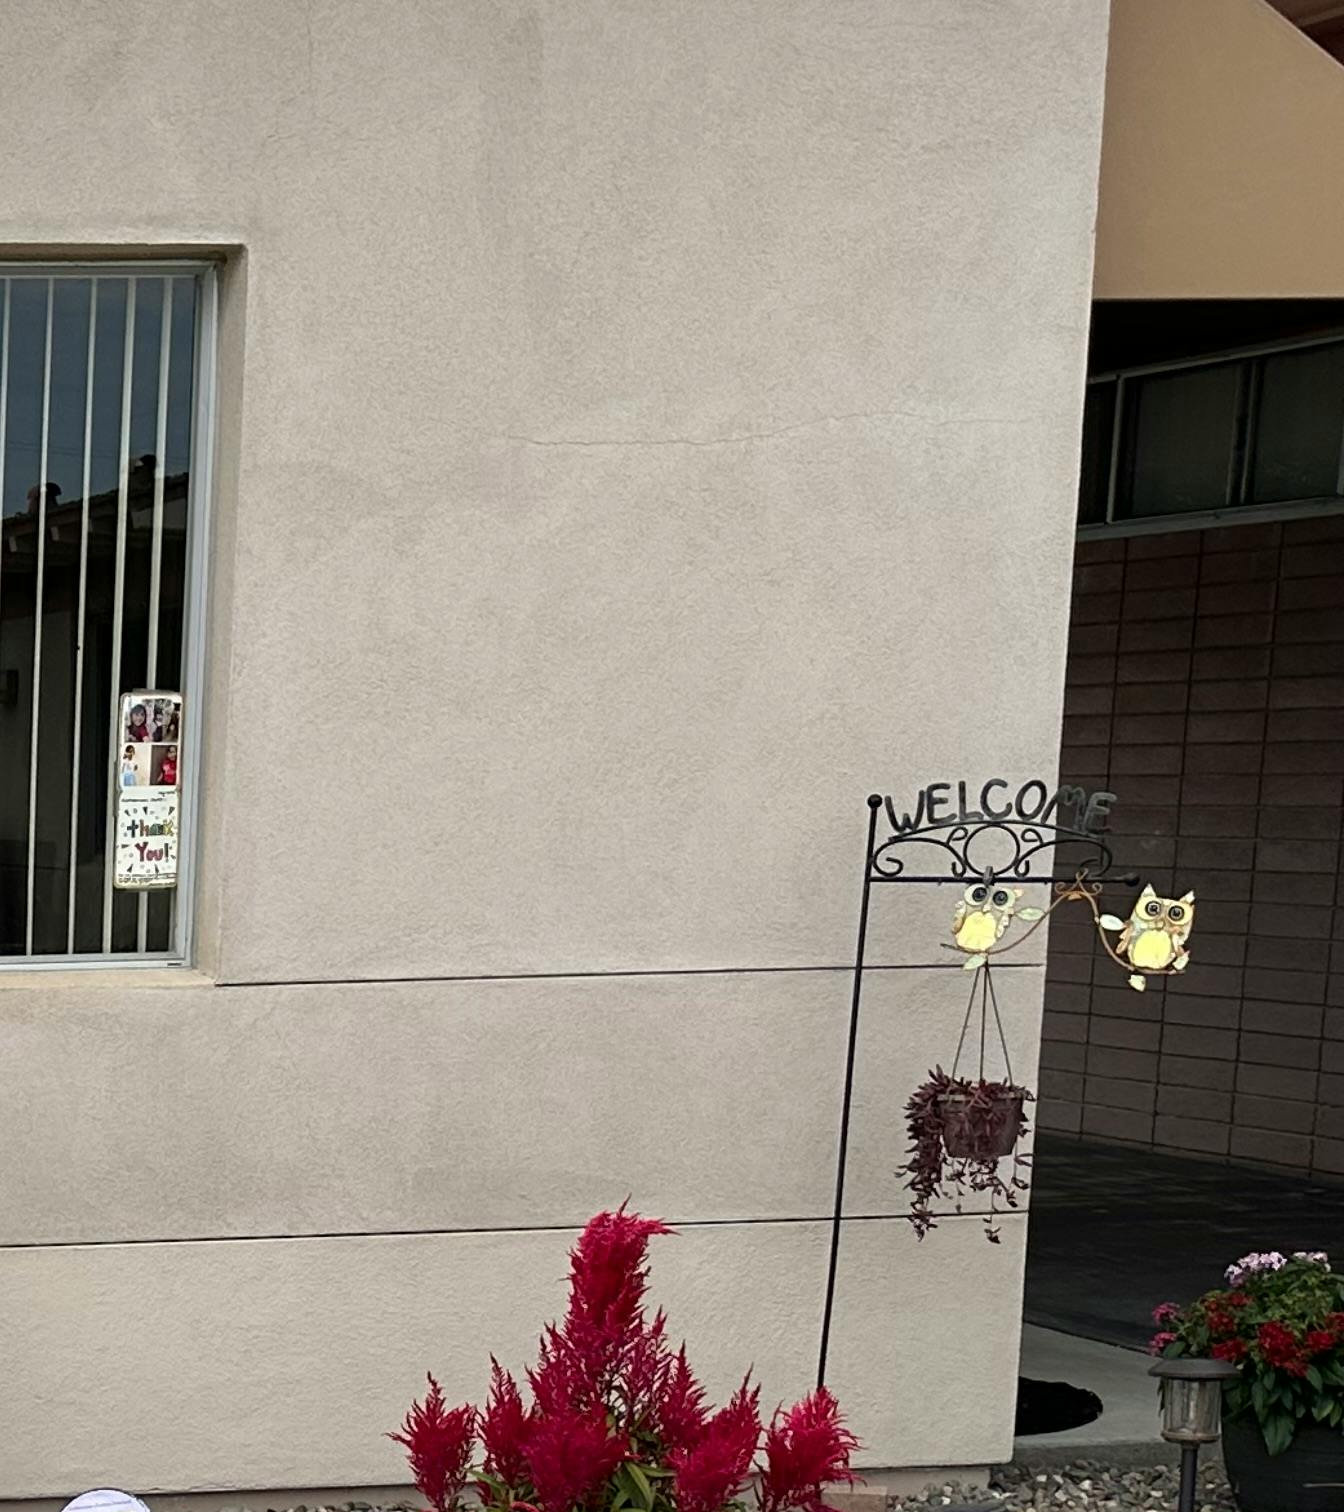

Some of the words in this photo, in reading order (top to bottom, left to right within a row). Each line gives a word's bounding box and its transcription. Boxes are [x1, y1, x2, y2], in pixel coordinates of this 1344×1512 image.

[885, 778, 1117, 834] WELCOME
[126, 819, 174, 838] thank
[134, 841, 169, 863] You!
